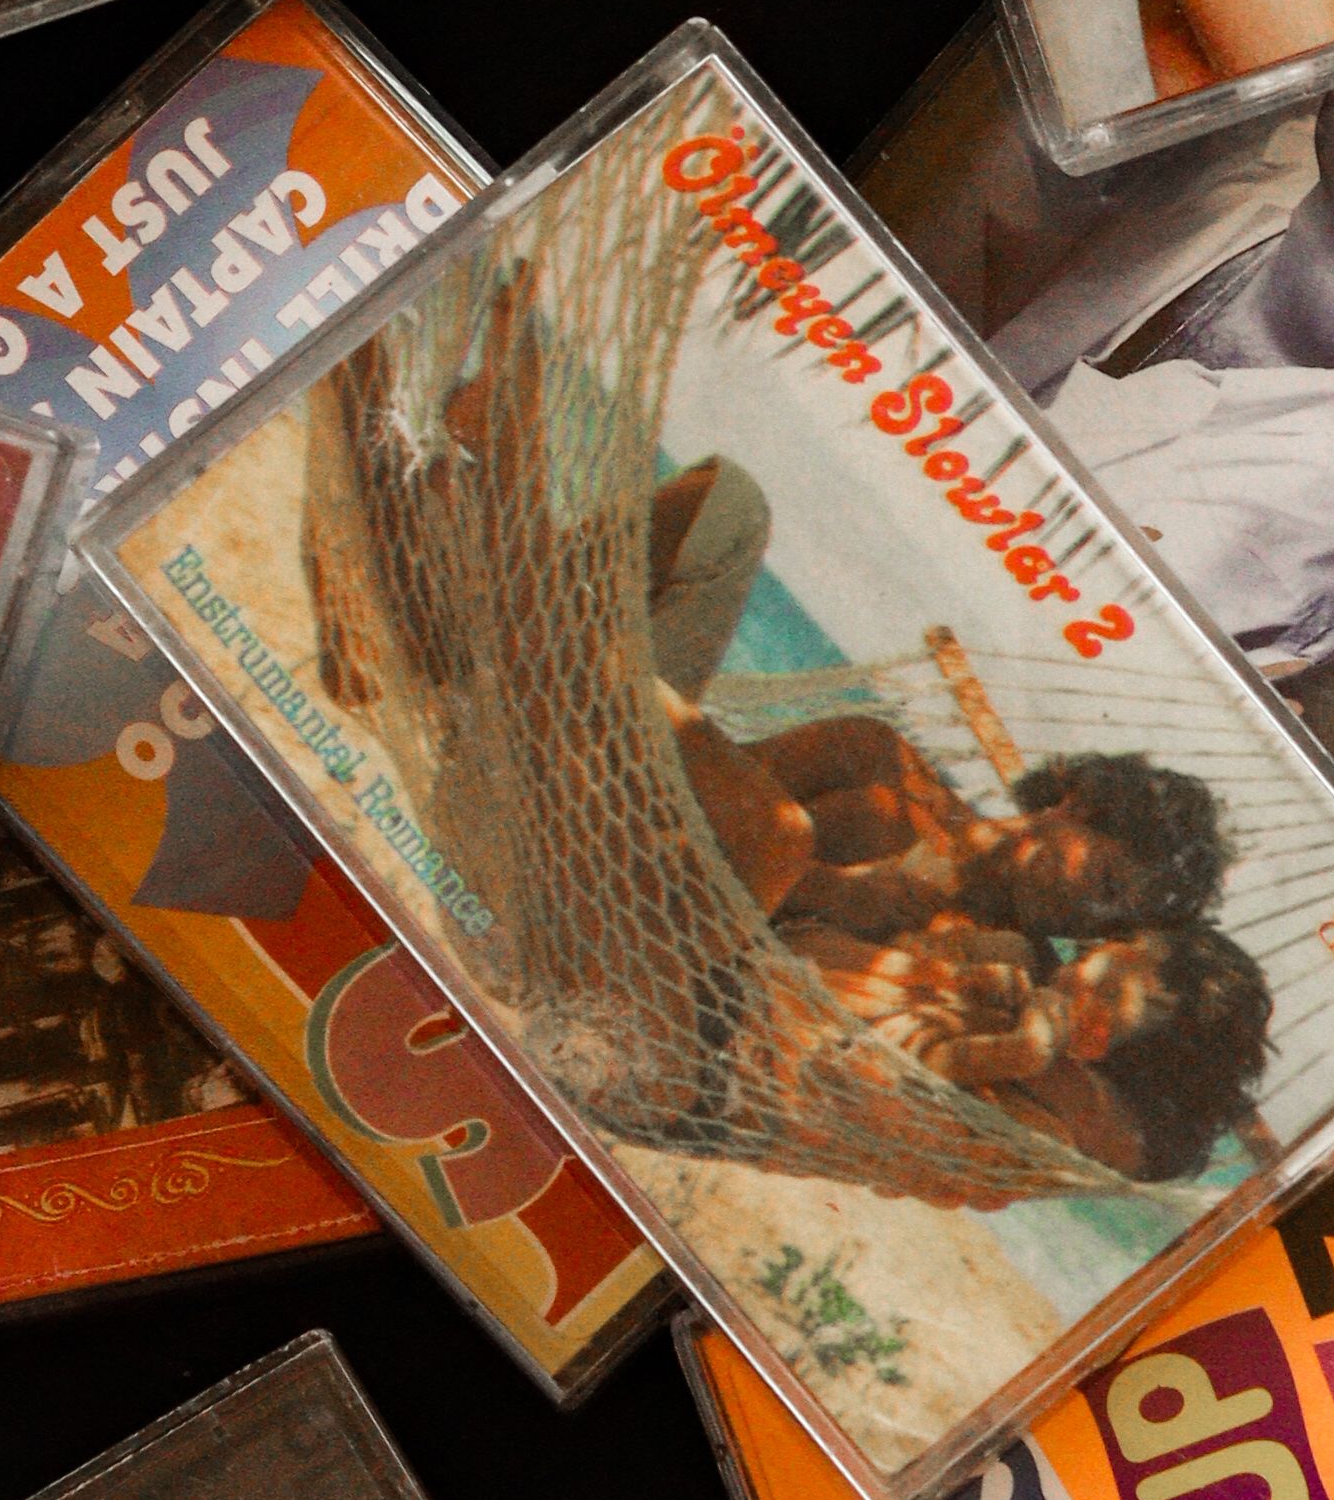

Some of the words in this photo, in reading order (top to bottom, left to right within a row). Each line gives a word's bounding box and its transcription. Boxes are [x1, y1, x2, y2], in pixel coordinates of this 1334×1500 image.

[14, 248, 96, 330] A
[62, 156, 336, 424] CAPTAIN
[72, 111, 241, 278] JUST
[869, 373, 1082, 608] Slowlar
